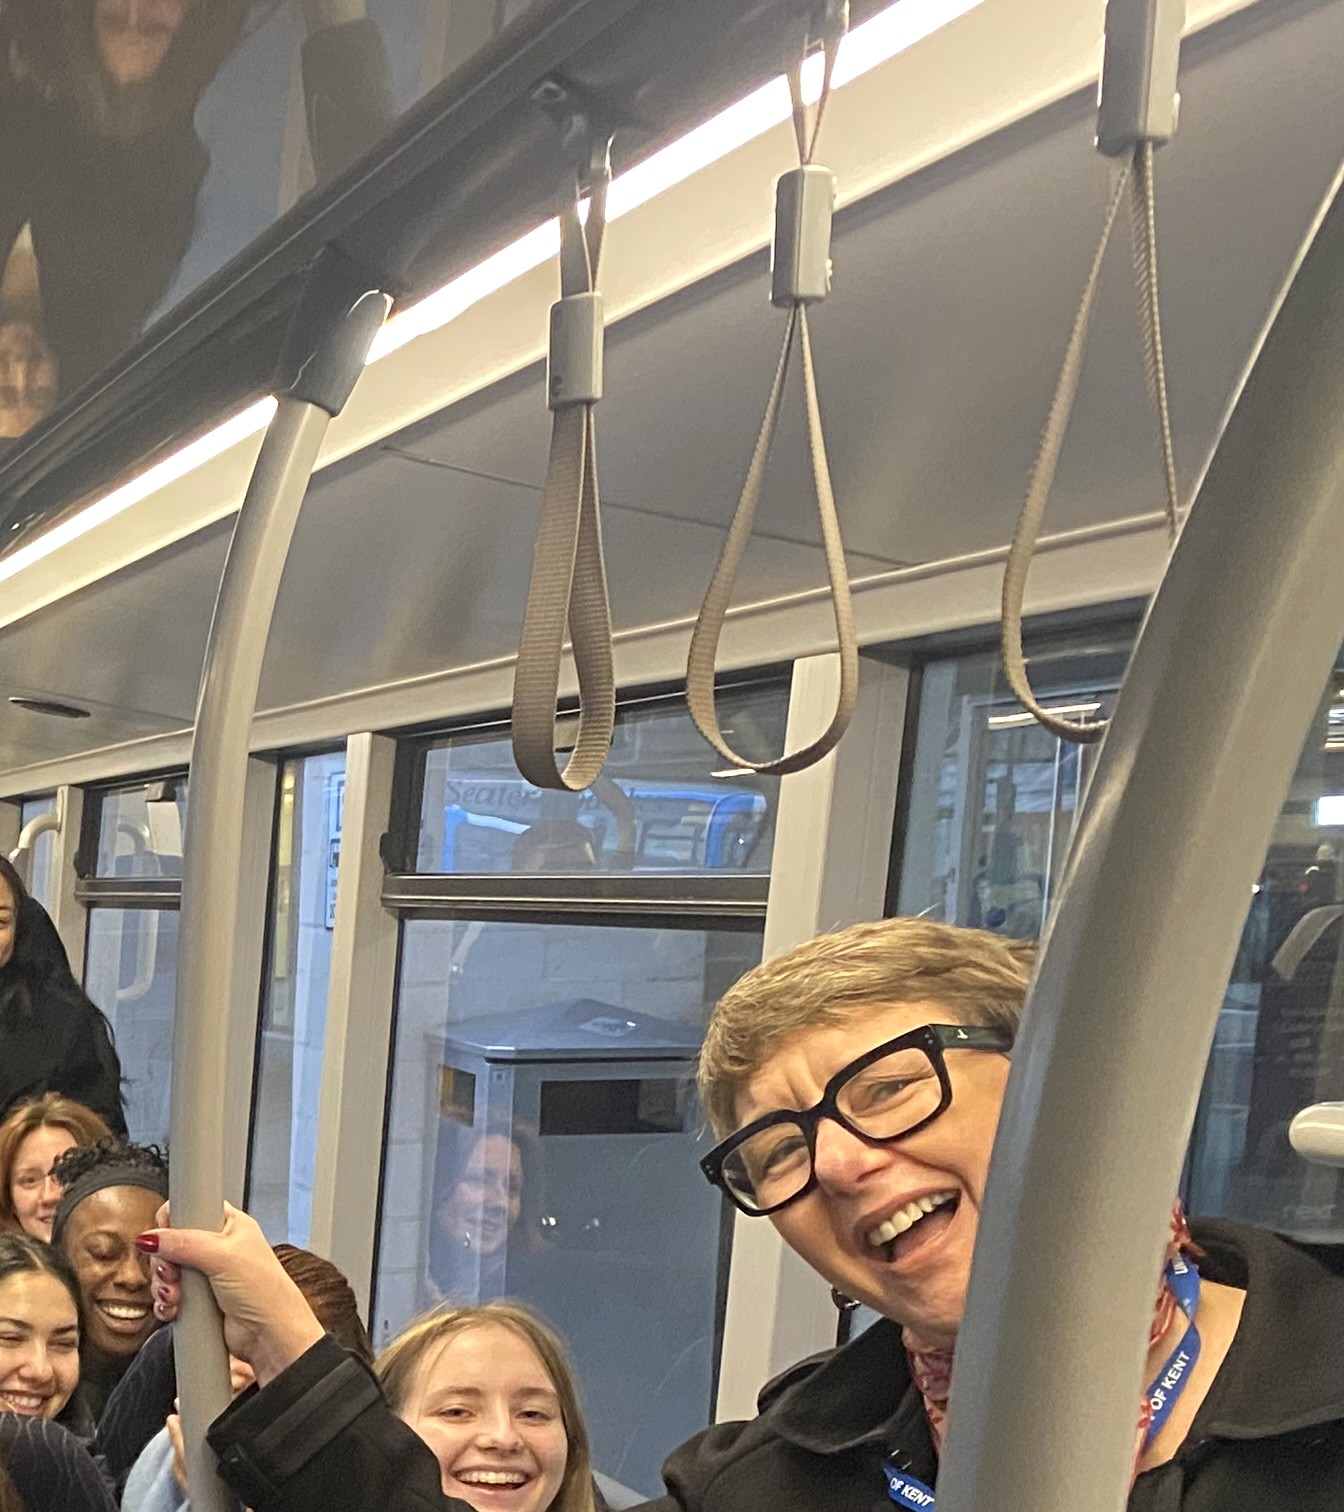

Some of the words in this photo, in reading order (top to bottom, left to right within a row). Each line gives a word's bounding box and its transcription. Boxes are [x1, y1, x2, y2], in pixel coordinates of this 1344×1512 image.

[1152, 1388, 1167, 1410] OF
[1161, 1351, 1190, 1390] KENT
[890, 1477, 905, 1491] OF
[900, 1484, 936, 1508] KENT
